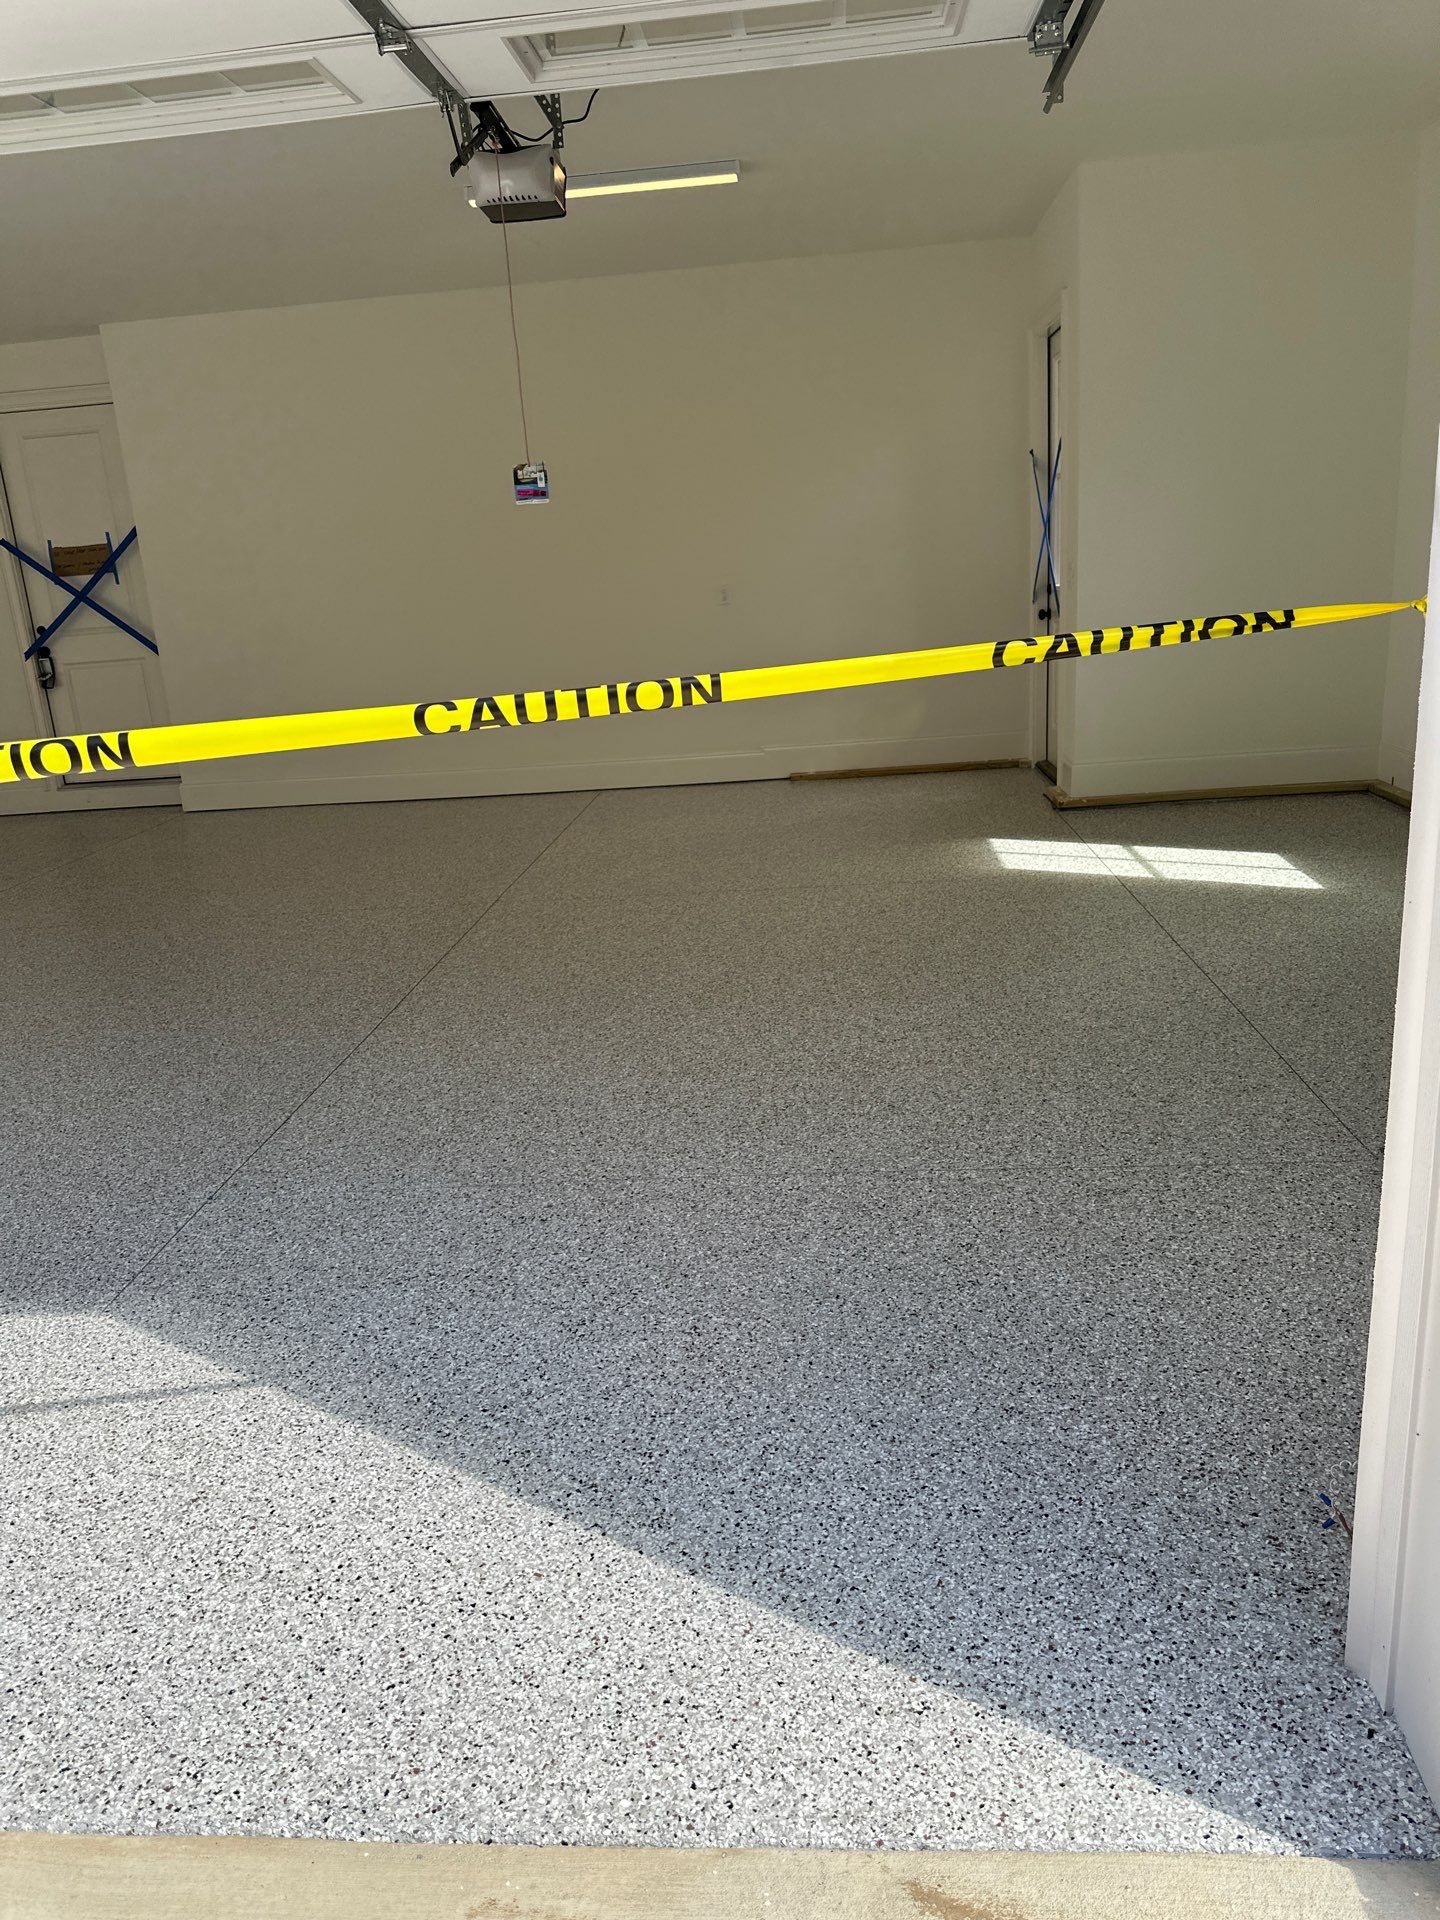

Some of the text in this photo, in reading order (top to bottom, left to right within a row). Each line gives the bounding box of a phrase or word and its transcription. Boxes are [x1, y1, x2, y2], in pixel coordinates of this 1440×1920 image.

[0, 609, 1295, 781] ION CAUTION CAUTION
